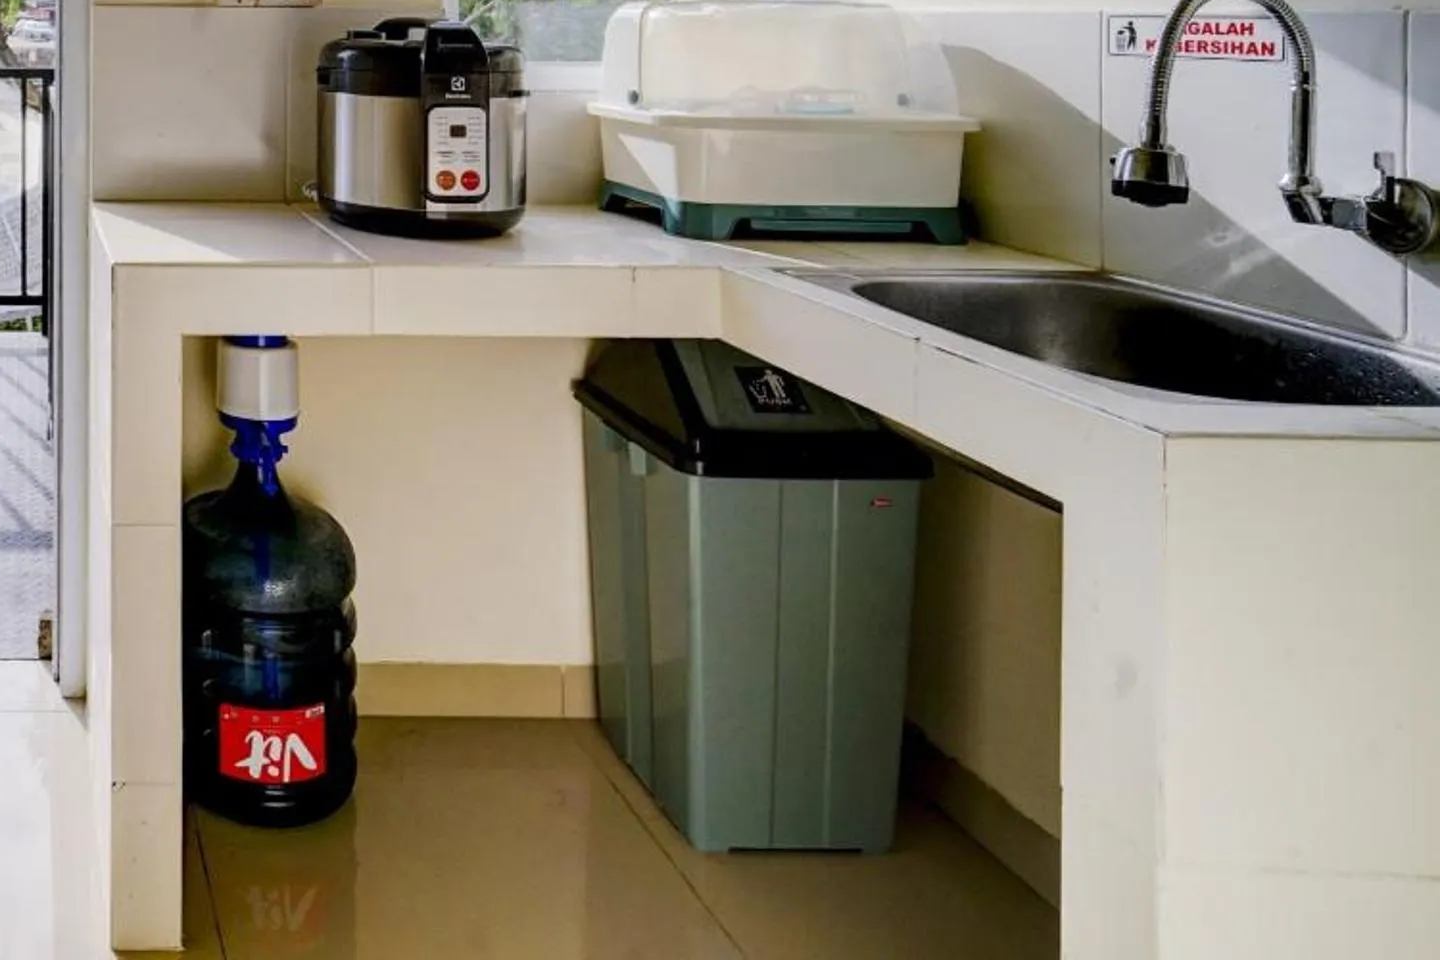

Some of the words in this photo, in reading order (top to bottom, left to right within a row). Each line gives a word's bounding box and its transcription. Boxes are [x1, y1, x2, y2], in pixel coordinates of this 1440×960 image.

[1183, 21, 1255, 36] GALAH
[1145, 39, 1276, 57] KBERSIHAN
[233, 730, 318, 783] Vit
